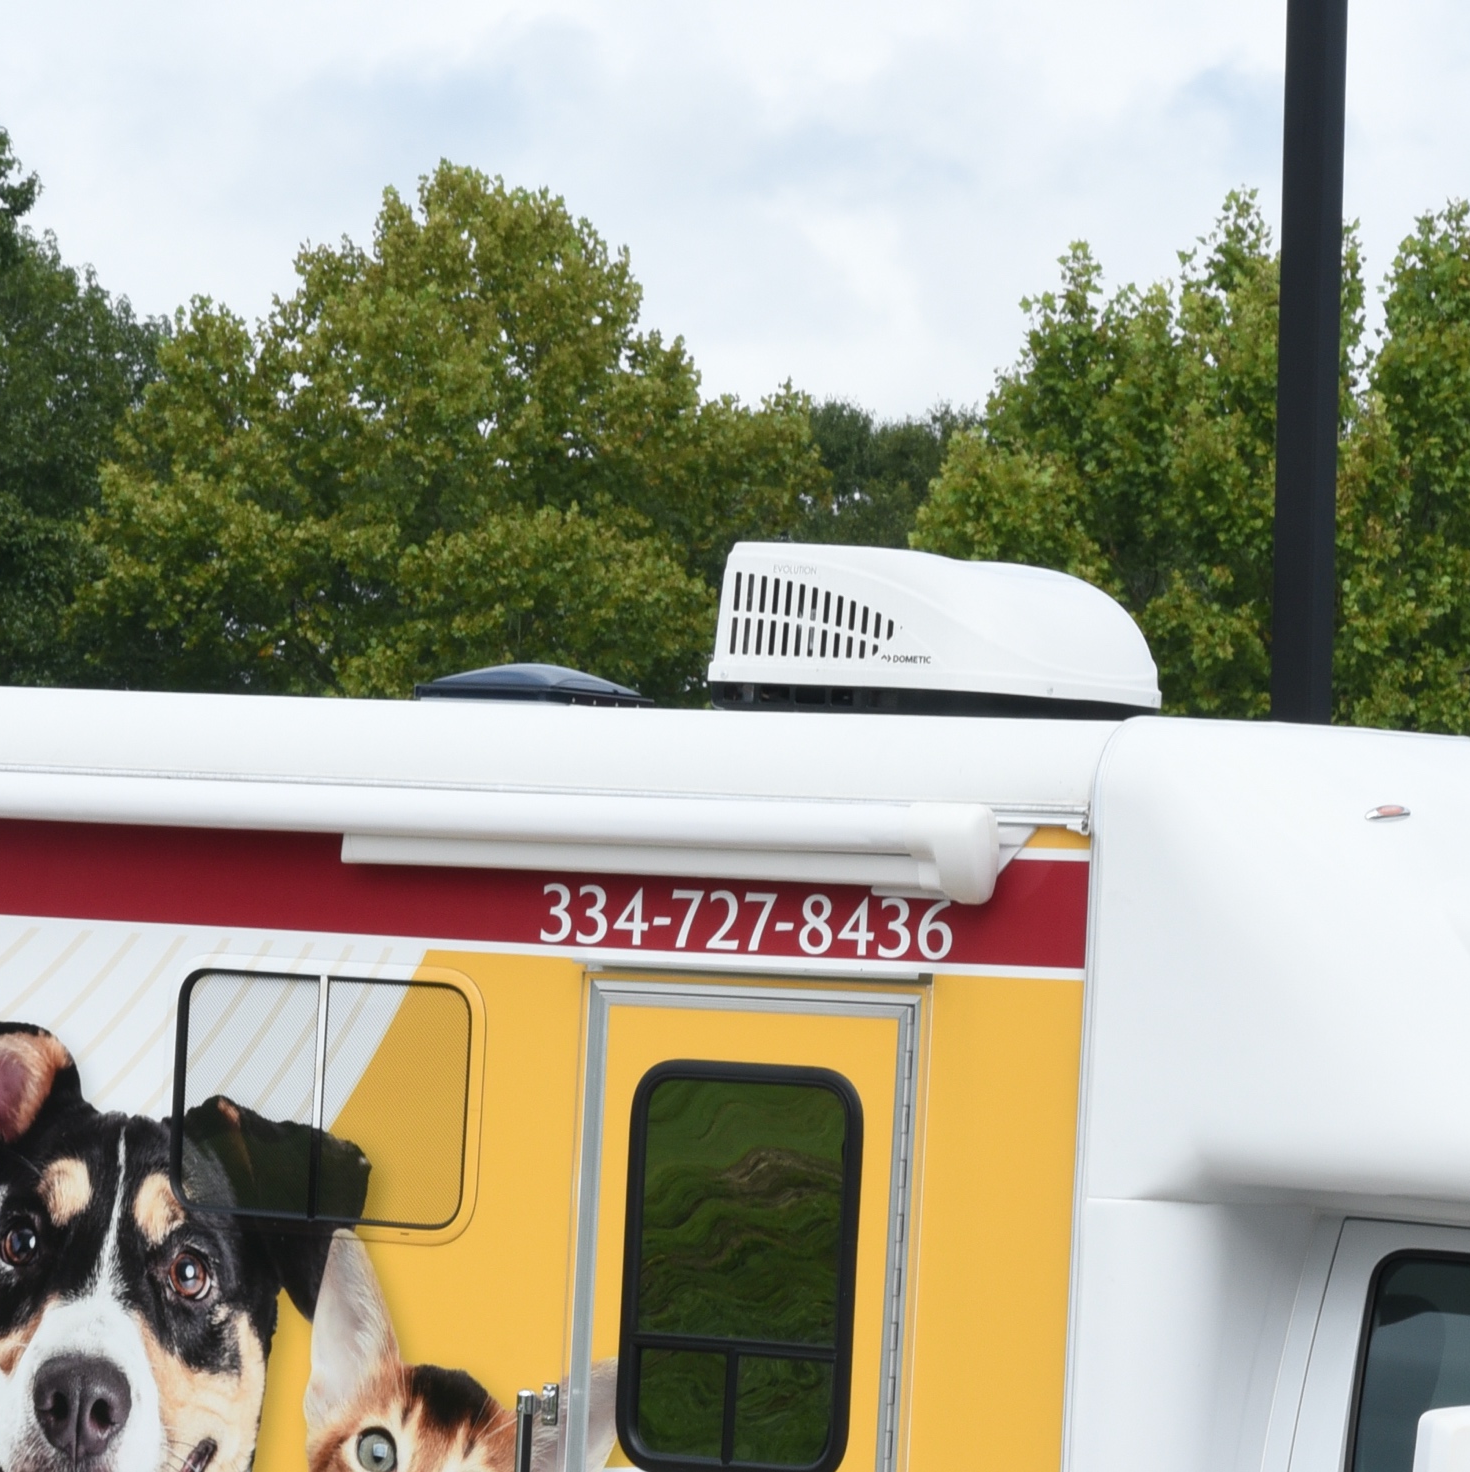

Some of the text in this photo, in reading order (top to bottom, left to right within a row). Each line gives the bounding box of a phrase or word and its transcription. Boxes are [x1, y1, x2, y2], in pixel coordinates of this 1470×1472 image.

[773, 563, 817, 575] EVOLUTION
[892, 655, 932, 664] DOMETIC
[539, 882, 954, 961] 334-727-8436
